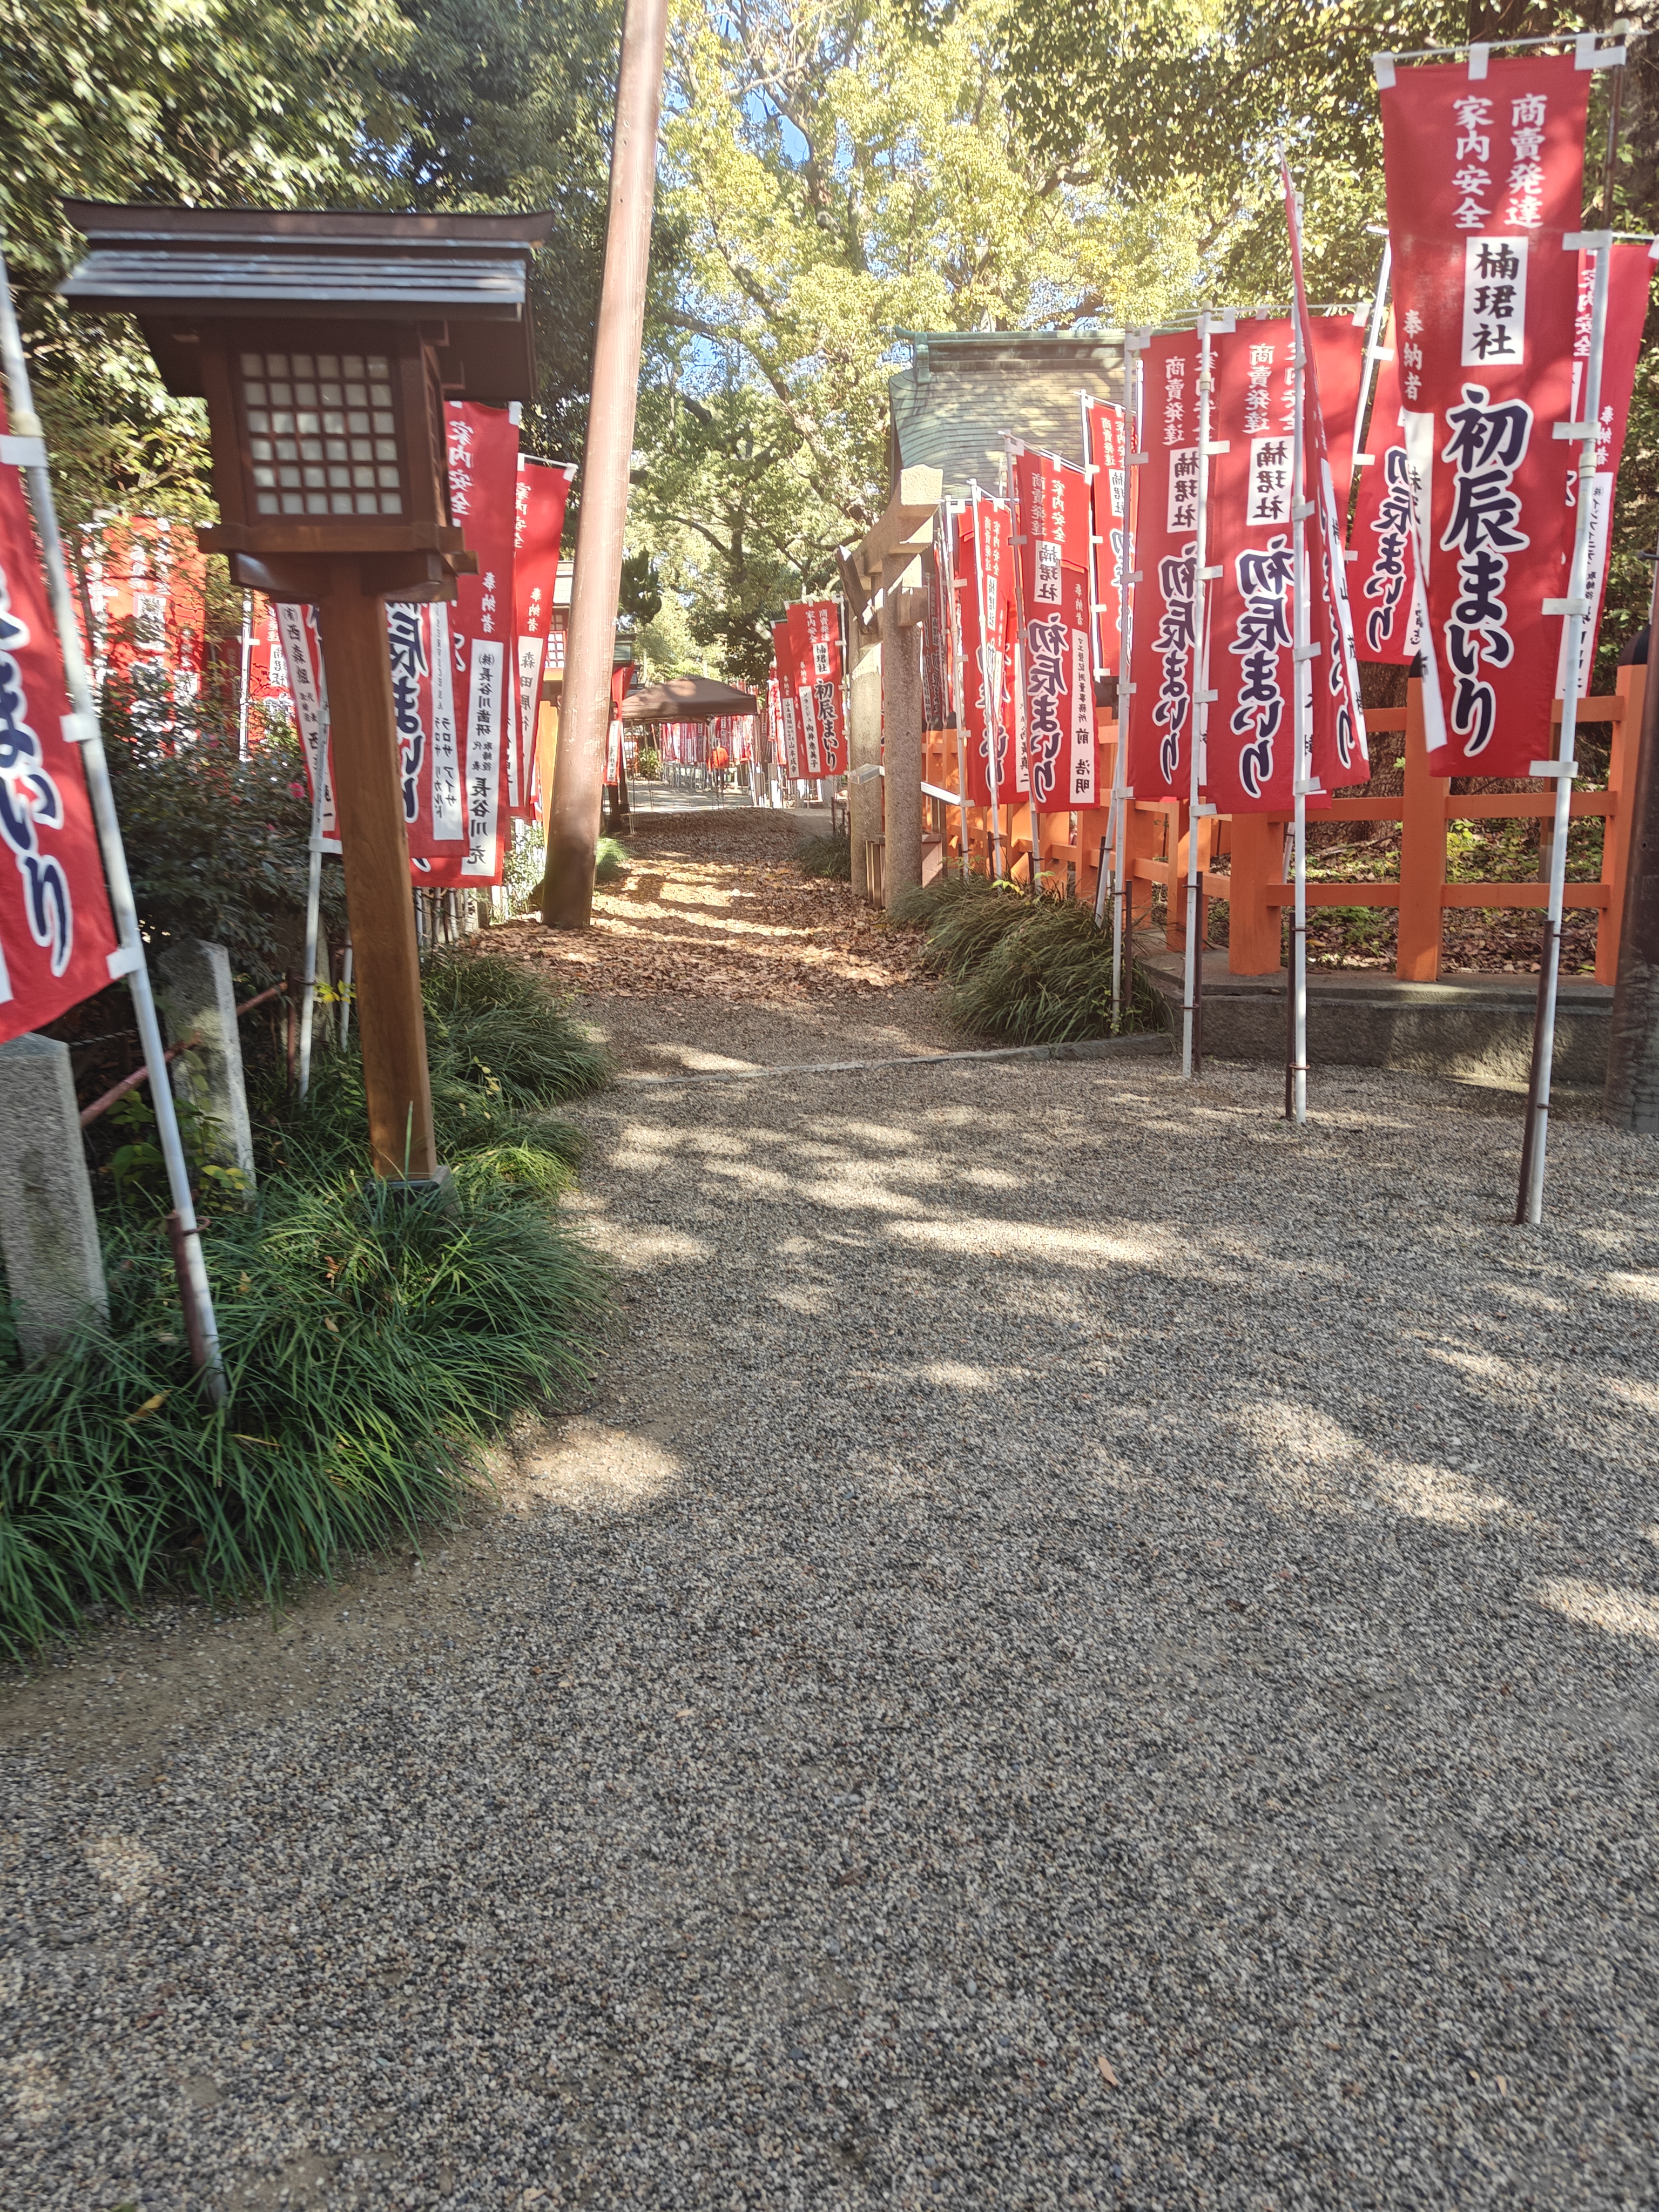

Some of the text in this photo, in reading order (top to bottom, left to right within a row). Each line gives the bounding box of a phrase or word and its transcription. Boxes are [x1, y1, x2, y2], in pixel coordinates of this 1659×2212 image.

[1452, 95, 1494, 229] 家内安全
[1504, 93, 1548, 229] 商賣発達
[1403, 308, 1422, 401] 奉納者
[1471, 243, 1520, 360] 楠珺社
[1440, 382, 1534, 757] 初辰まいり
[813, 678, 840, 773] 初辰まいり
